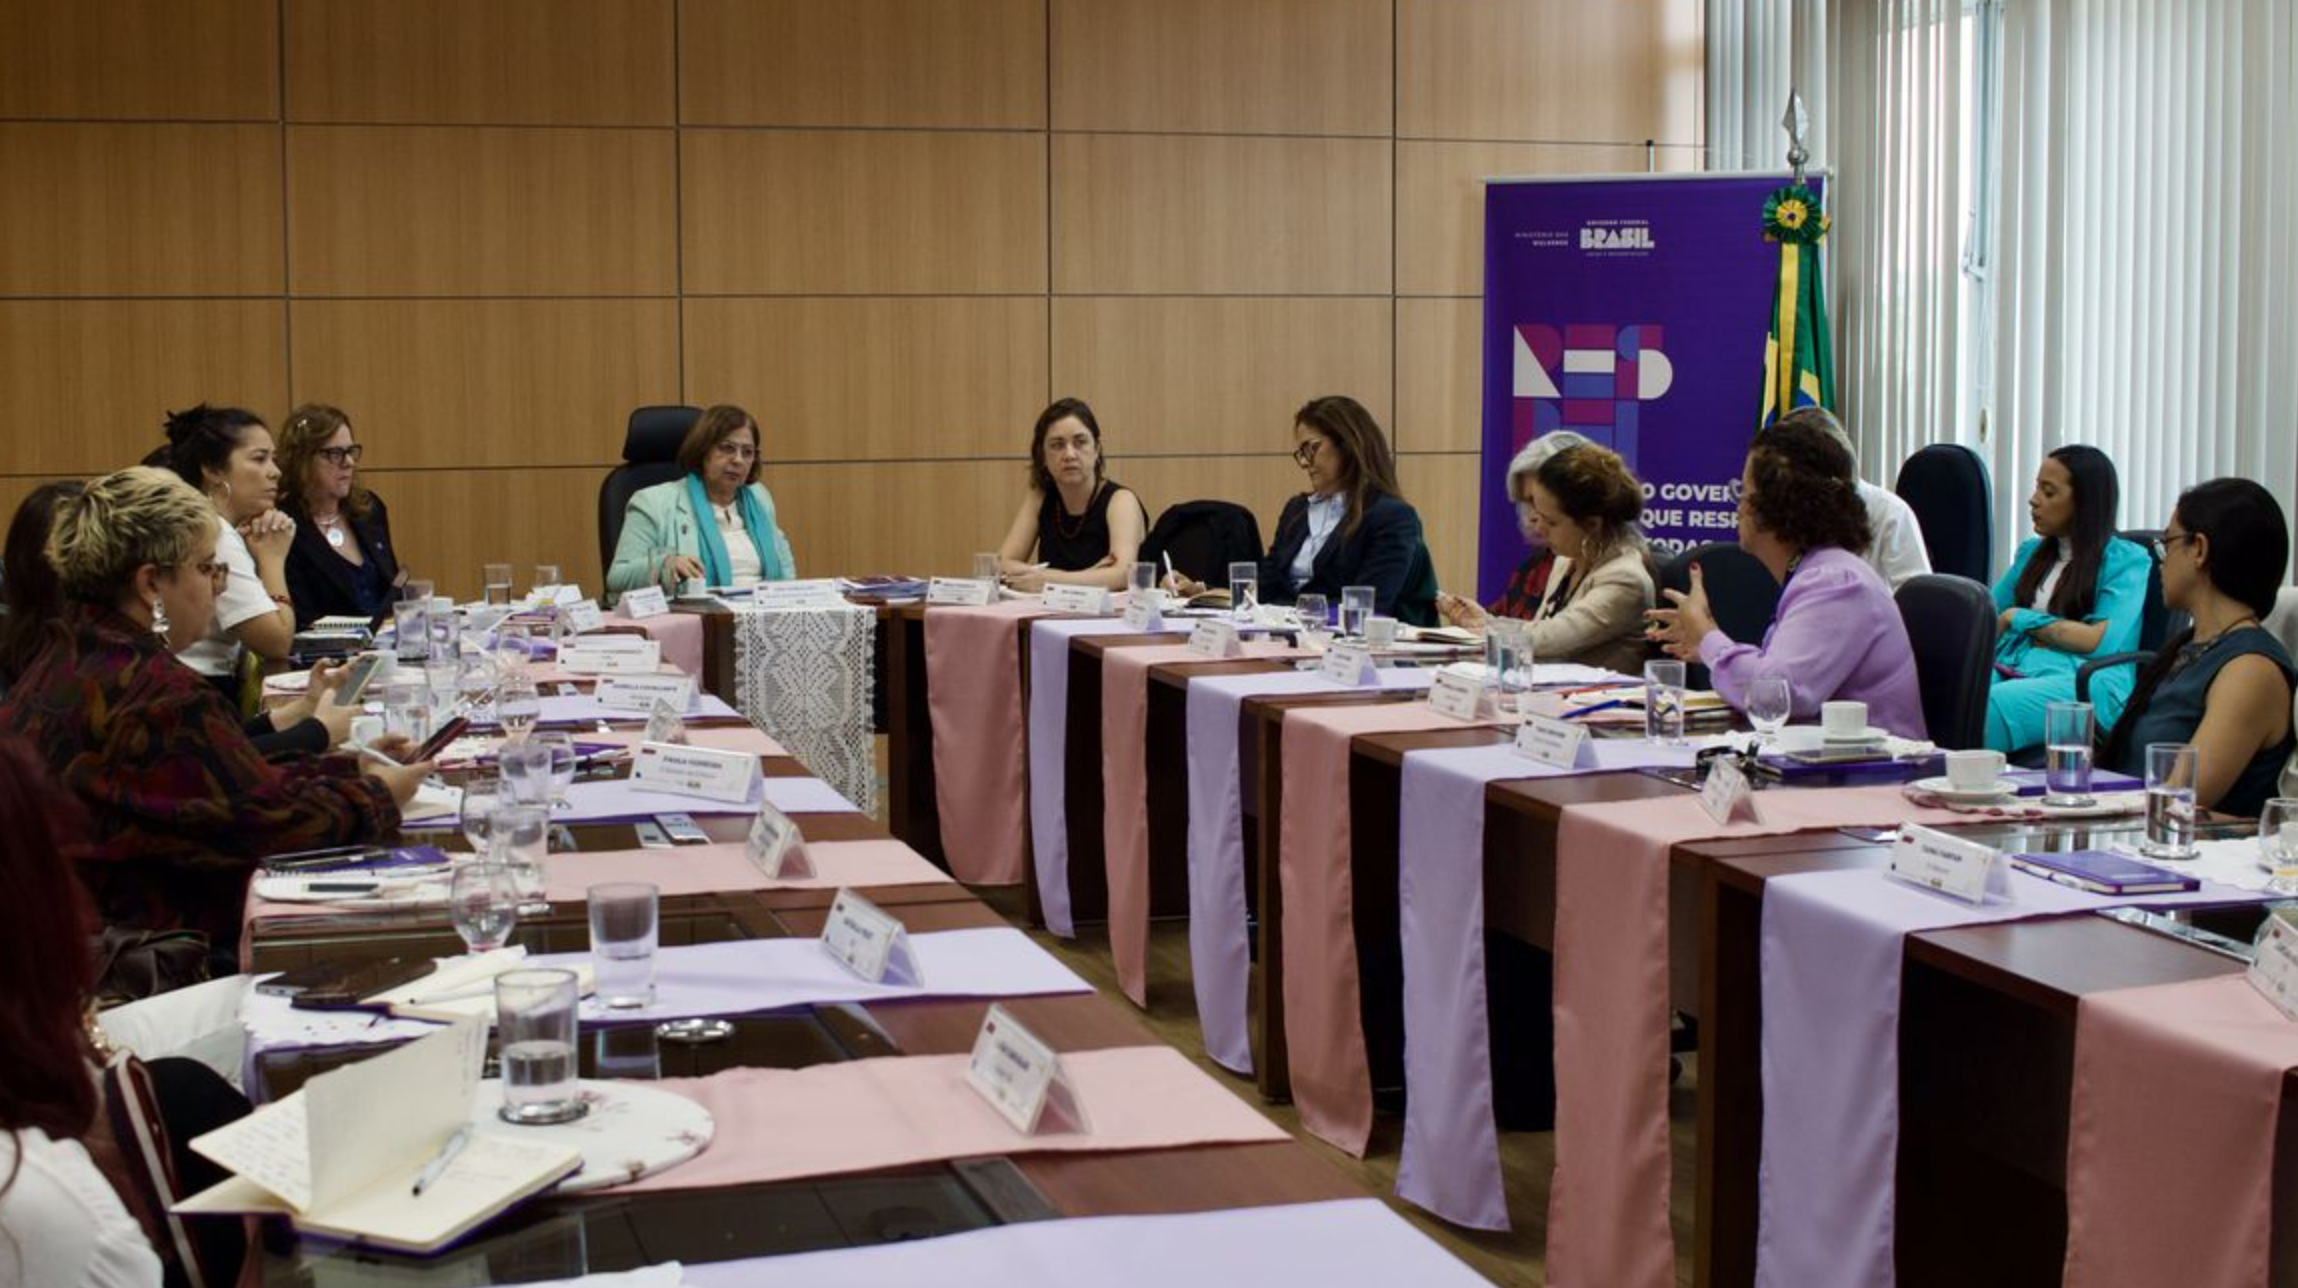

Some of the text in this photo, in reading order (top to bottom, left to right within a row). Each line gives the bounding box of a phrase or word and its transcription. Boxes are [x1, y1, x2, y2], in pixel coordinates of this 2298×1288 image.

[1580, 228, 1655, 249] BRASIL
[1641, 482, 1656, 499] O
[1640, 509, 1683, 529] QUE
